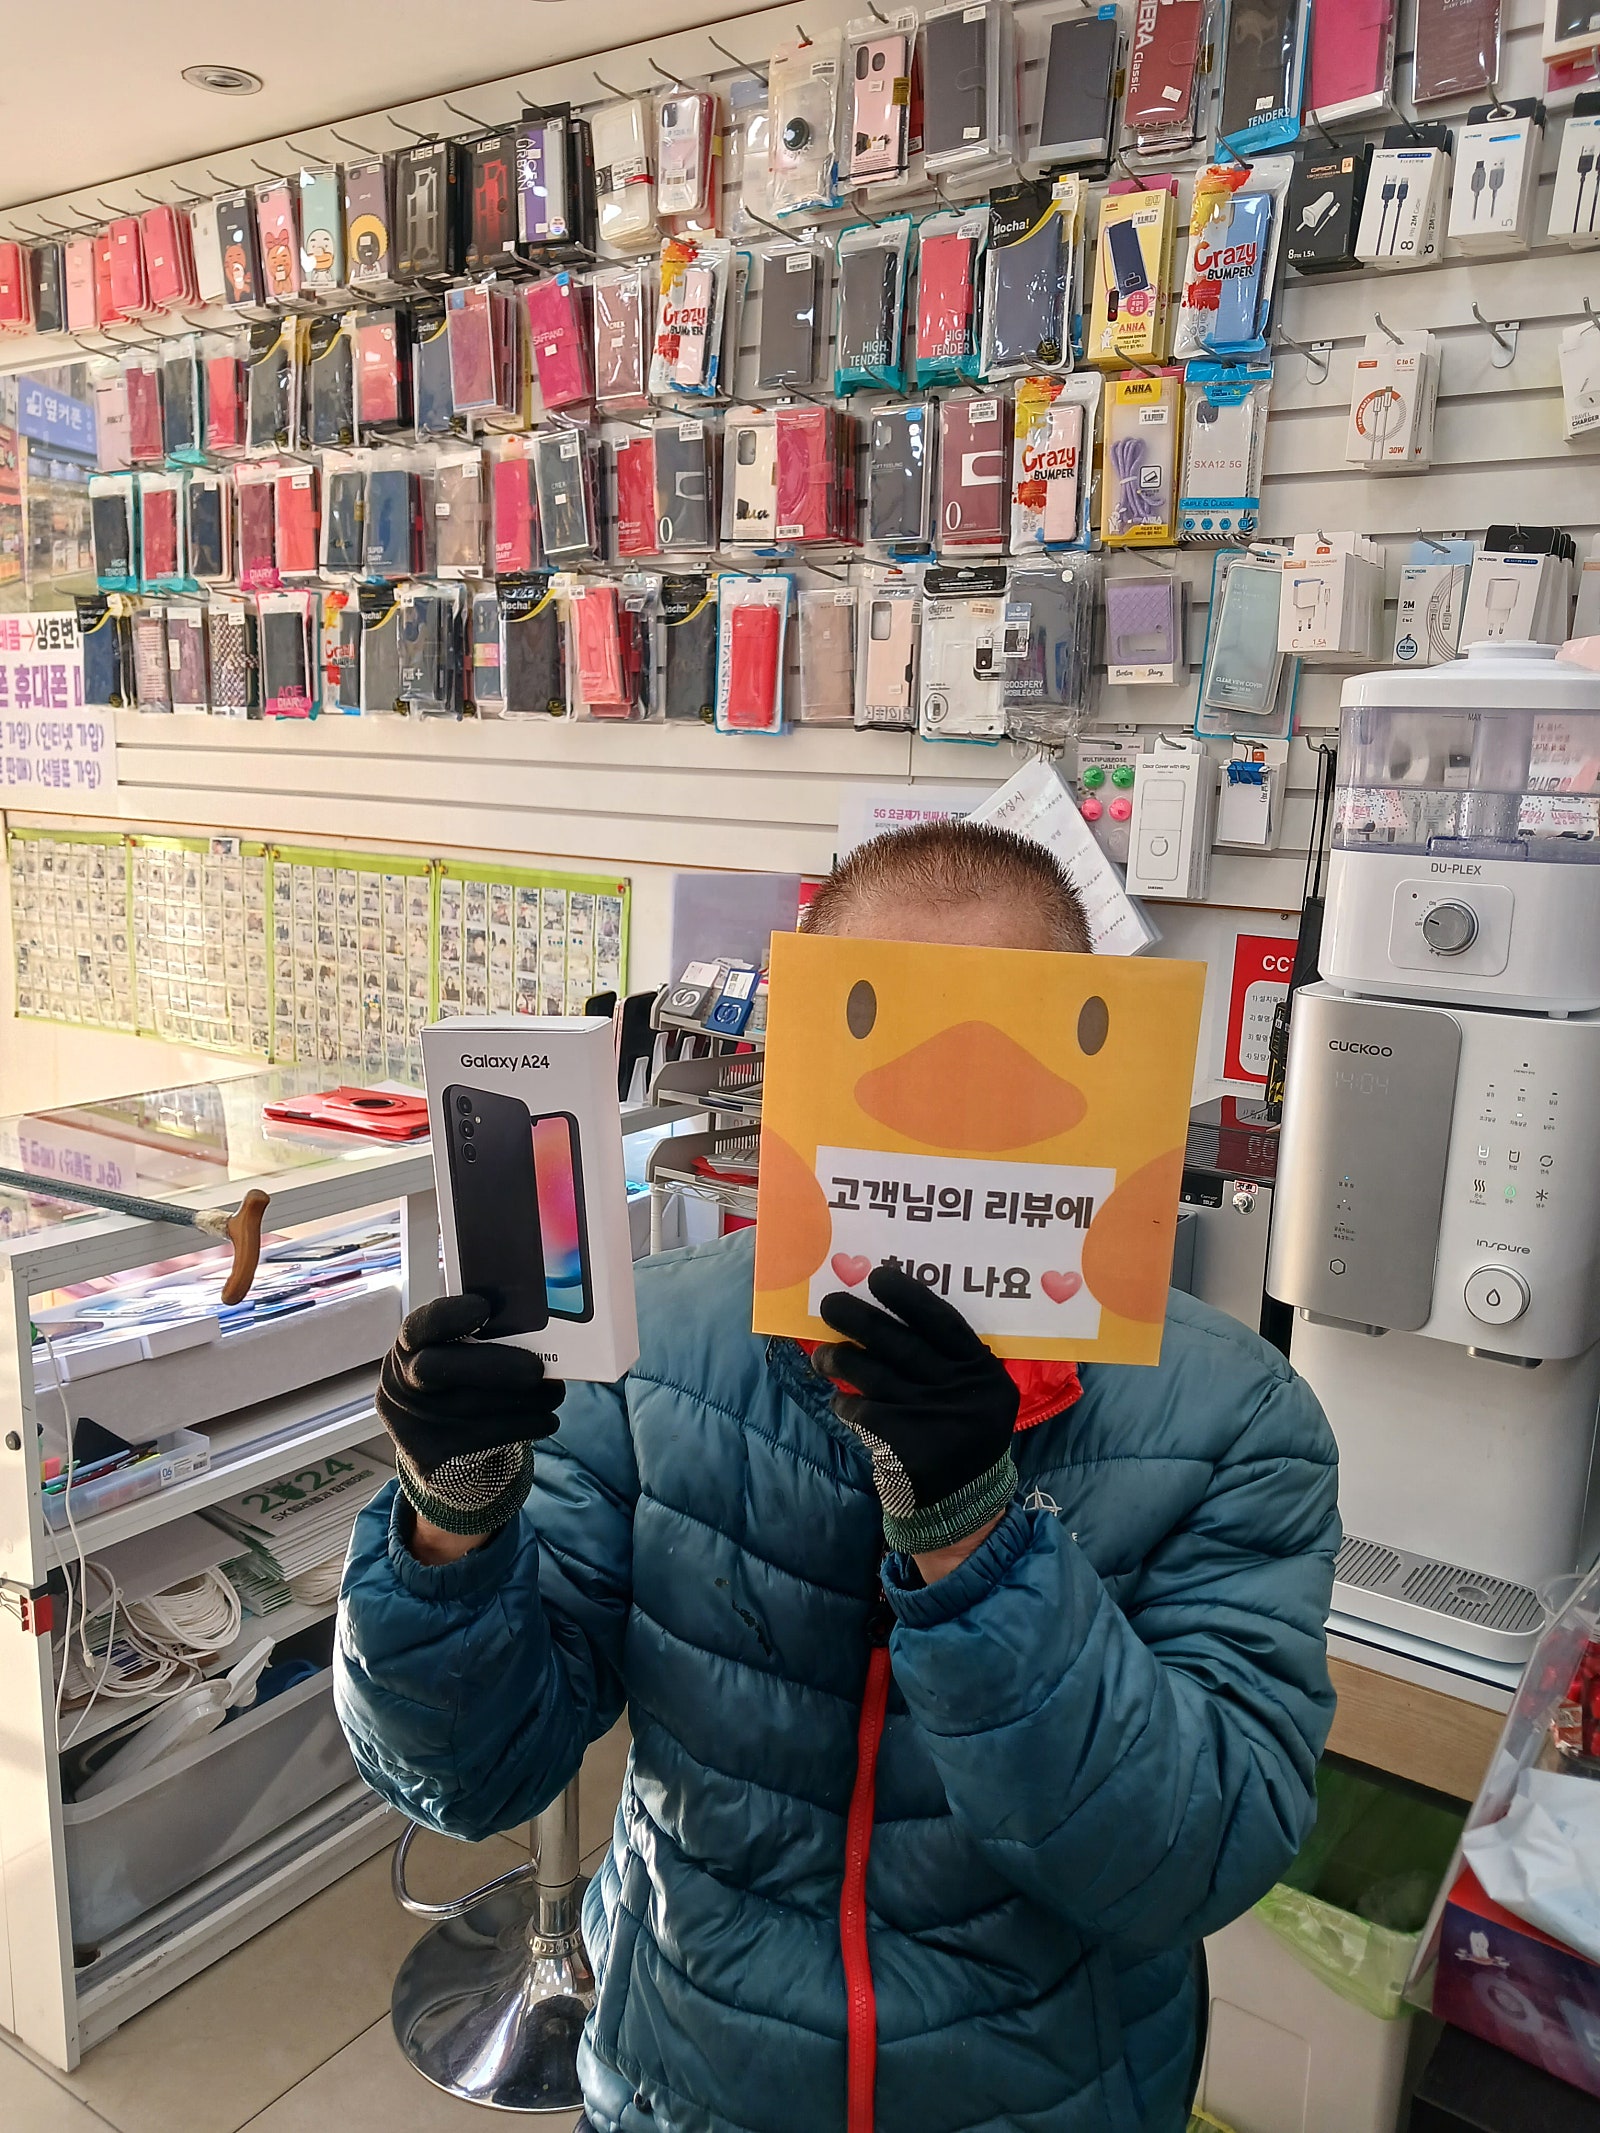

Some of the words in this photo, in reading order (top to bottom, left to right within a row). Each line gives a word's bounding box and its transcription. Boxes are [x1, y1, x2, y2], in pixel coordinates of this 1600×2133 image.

[1130, 52, 1144, 94] Classic
[1193, 240, 1258, 273] Crazy
[1206, 265, 1254, 281] BUMPER
[662, 302, 706, 326] Crazy
[418, 322, 438, 333] ocha!
[1118, 322, 1146, 334] ANNA
[944, 329, 970, 343] HIGH
[311, 339, 329, 350] ocha!
[862, 340, 888, 354] HIGH
[930, 341, 970, 355] TENDER
[850, 352, 888, 367] TENDER
[1124, 384, 1152, 394] ANNA
[1572, 414, 1600, 427] CHARGER
[1021, 444, 1076, 473] Crazy
[1229, 460, 1242, 469] 5G
[1034, 467, 1075, 481] BUMPER
[1204, 498, 1209, 507] &
[250, 568, 274, 579] DIARY
[665, 603, 690, 614] ocha!
[1402, 600, 1415, 609] 2M
[14, 664, 68, 708] 휴대폰
[1004, 680, 1043, 689] GOOSPERY
[277, 697, 304, 708] DIARY
[1468, 713, 1482, 722] MAX
[76, 722, 104, 752] 가입)
[73, 760, 102, 789] 가입)
[873, 808, 886, 819] 5G
[887, 808, 920, 821] 요금제가
[1430, 862, 1482, 876] DU-PLEX
[1262, 955, 1296, 973] CC
[1328, 1040, 1393, 1058] CUCKOO
[460, 1054, 518, 1073] Galaxy
[521, 1054, 550, 1069] A24
[827, 1176, 972, 1223] 고객님의
[984, 1188, 1094, 1230] 리뷰에
[962, 1265, 1031, 1300] 나요
[162, 1466, 173, 1478] 06
